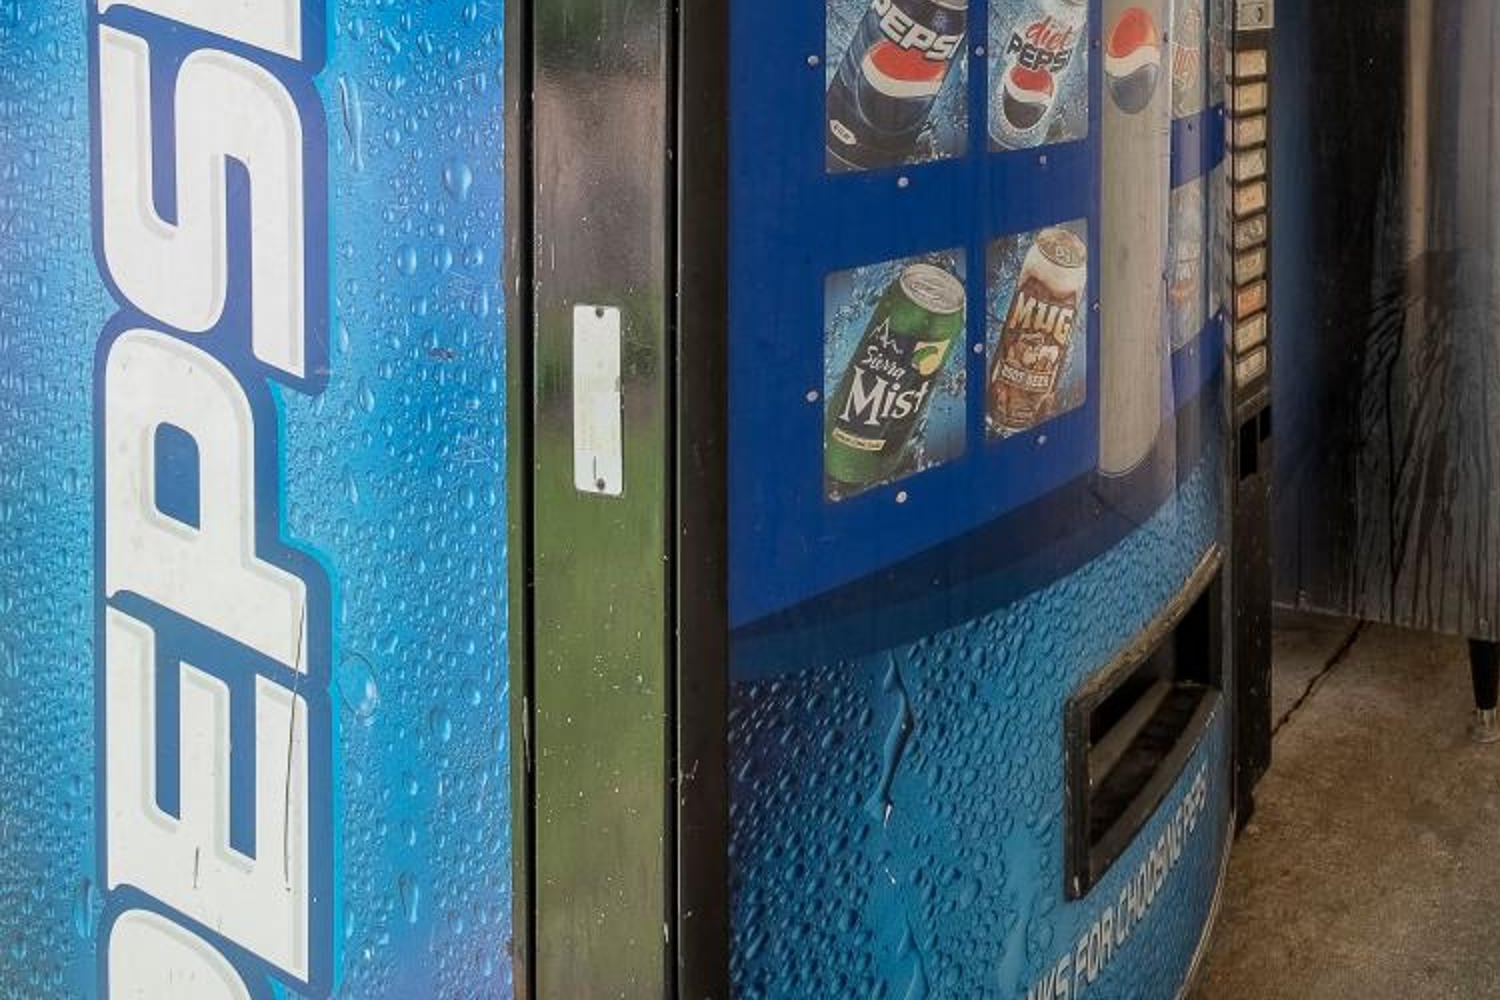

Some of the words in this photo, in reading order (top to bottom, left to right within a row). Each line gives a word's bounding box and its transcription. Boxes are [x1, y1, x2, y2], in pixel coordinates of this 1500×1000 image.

[1006, 31, 1073, 73] PEPSI
[1008, 291, 1075, 346] MUG
[838, 364, 930, 426] Mist
